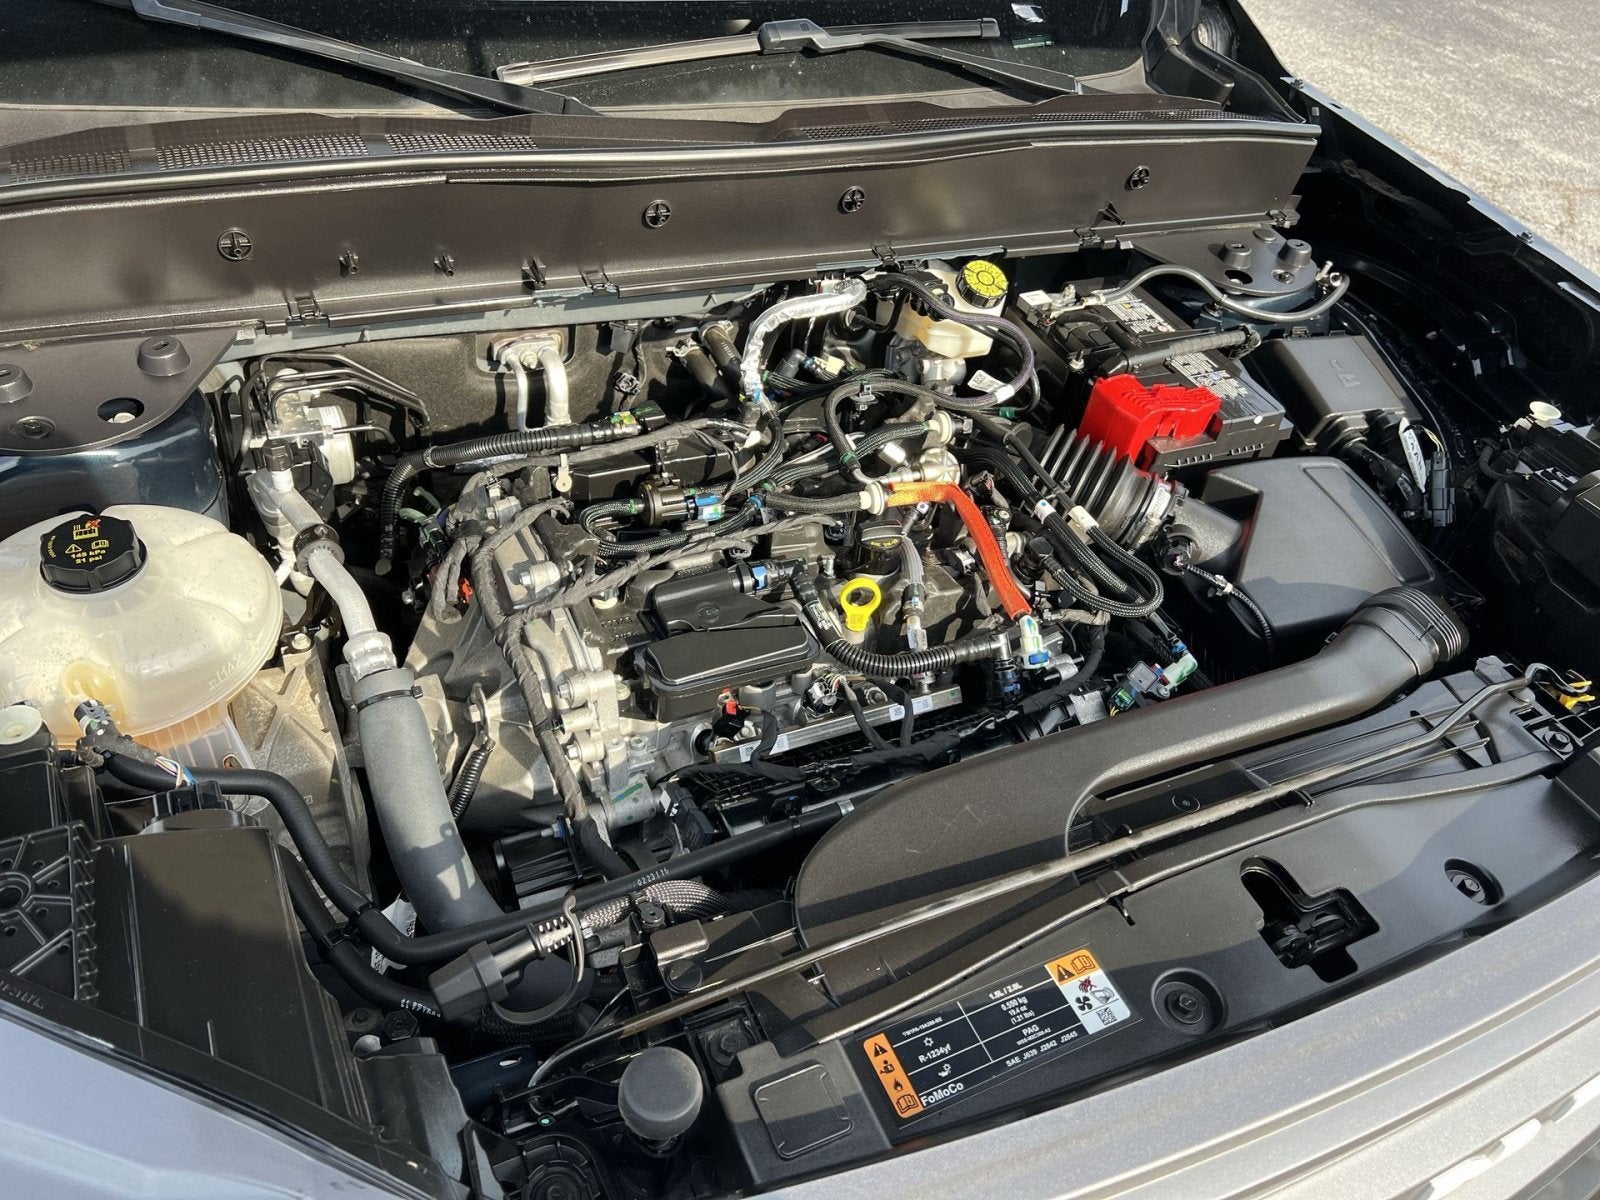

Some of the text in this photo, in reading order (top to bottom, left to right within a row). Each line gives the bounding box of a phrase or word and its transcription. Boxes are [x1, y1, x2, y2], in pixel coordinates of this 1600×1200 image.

[88, 555, 103, 563] psi
[1000, 996, 1028, 1011] 0.550 kg
[1010, 1015, 1023, 1025] (1.21
[1021, 1024, 1039, 1036] PAG
[918, 1043, 951, 1063] R-1234yf
[1005, 1056, 1021, 1067] SAE
[1023, 1048, 1038, 1060] J639
[1039, 1039, 1058, 1052] J2842
[920, 1082, 964, 1107] FoMoCo
